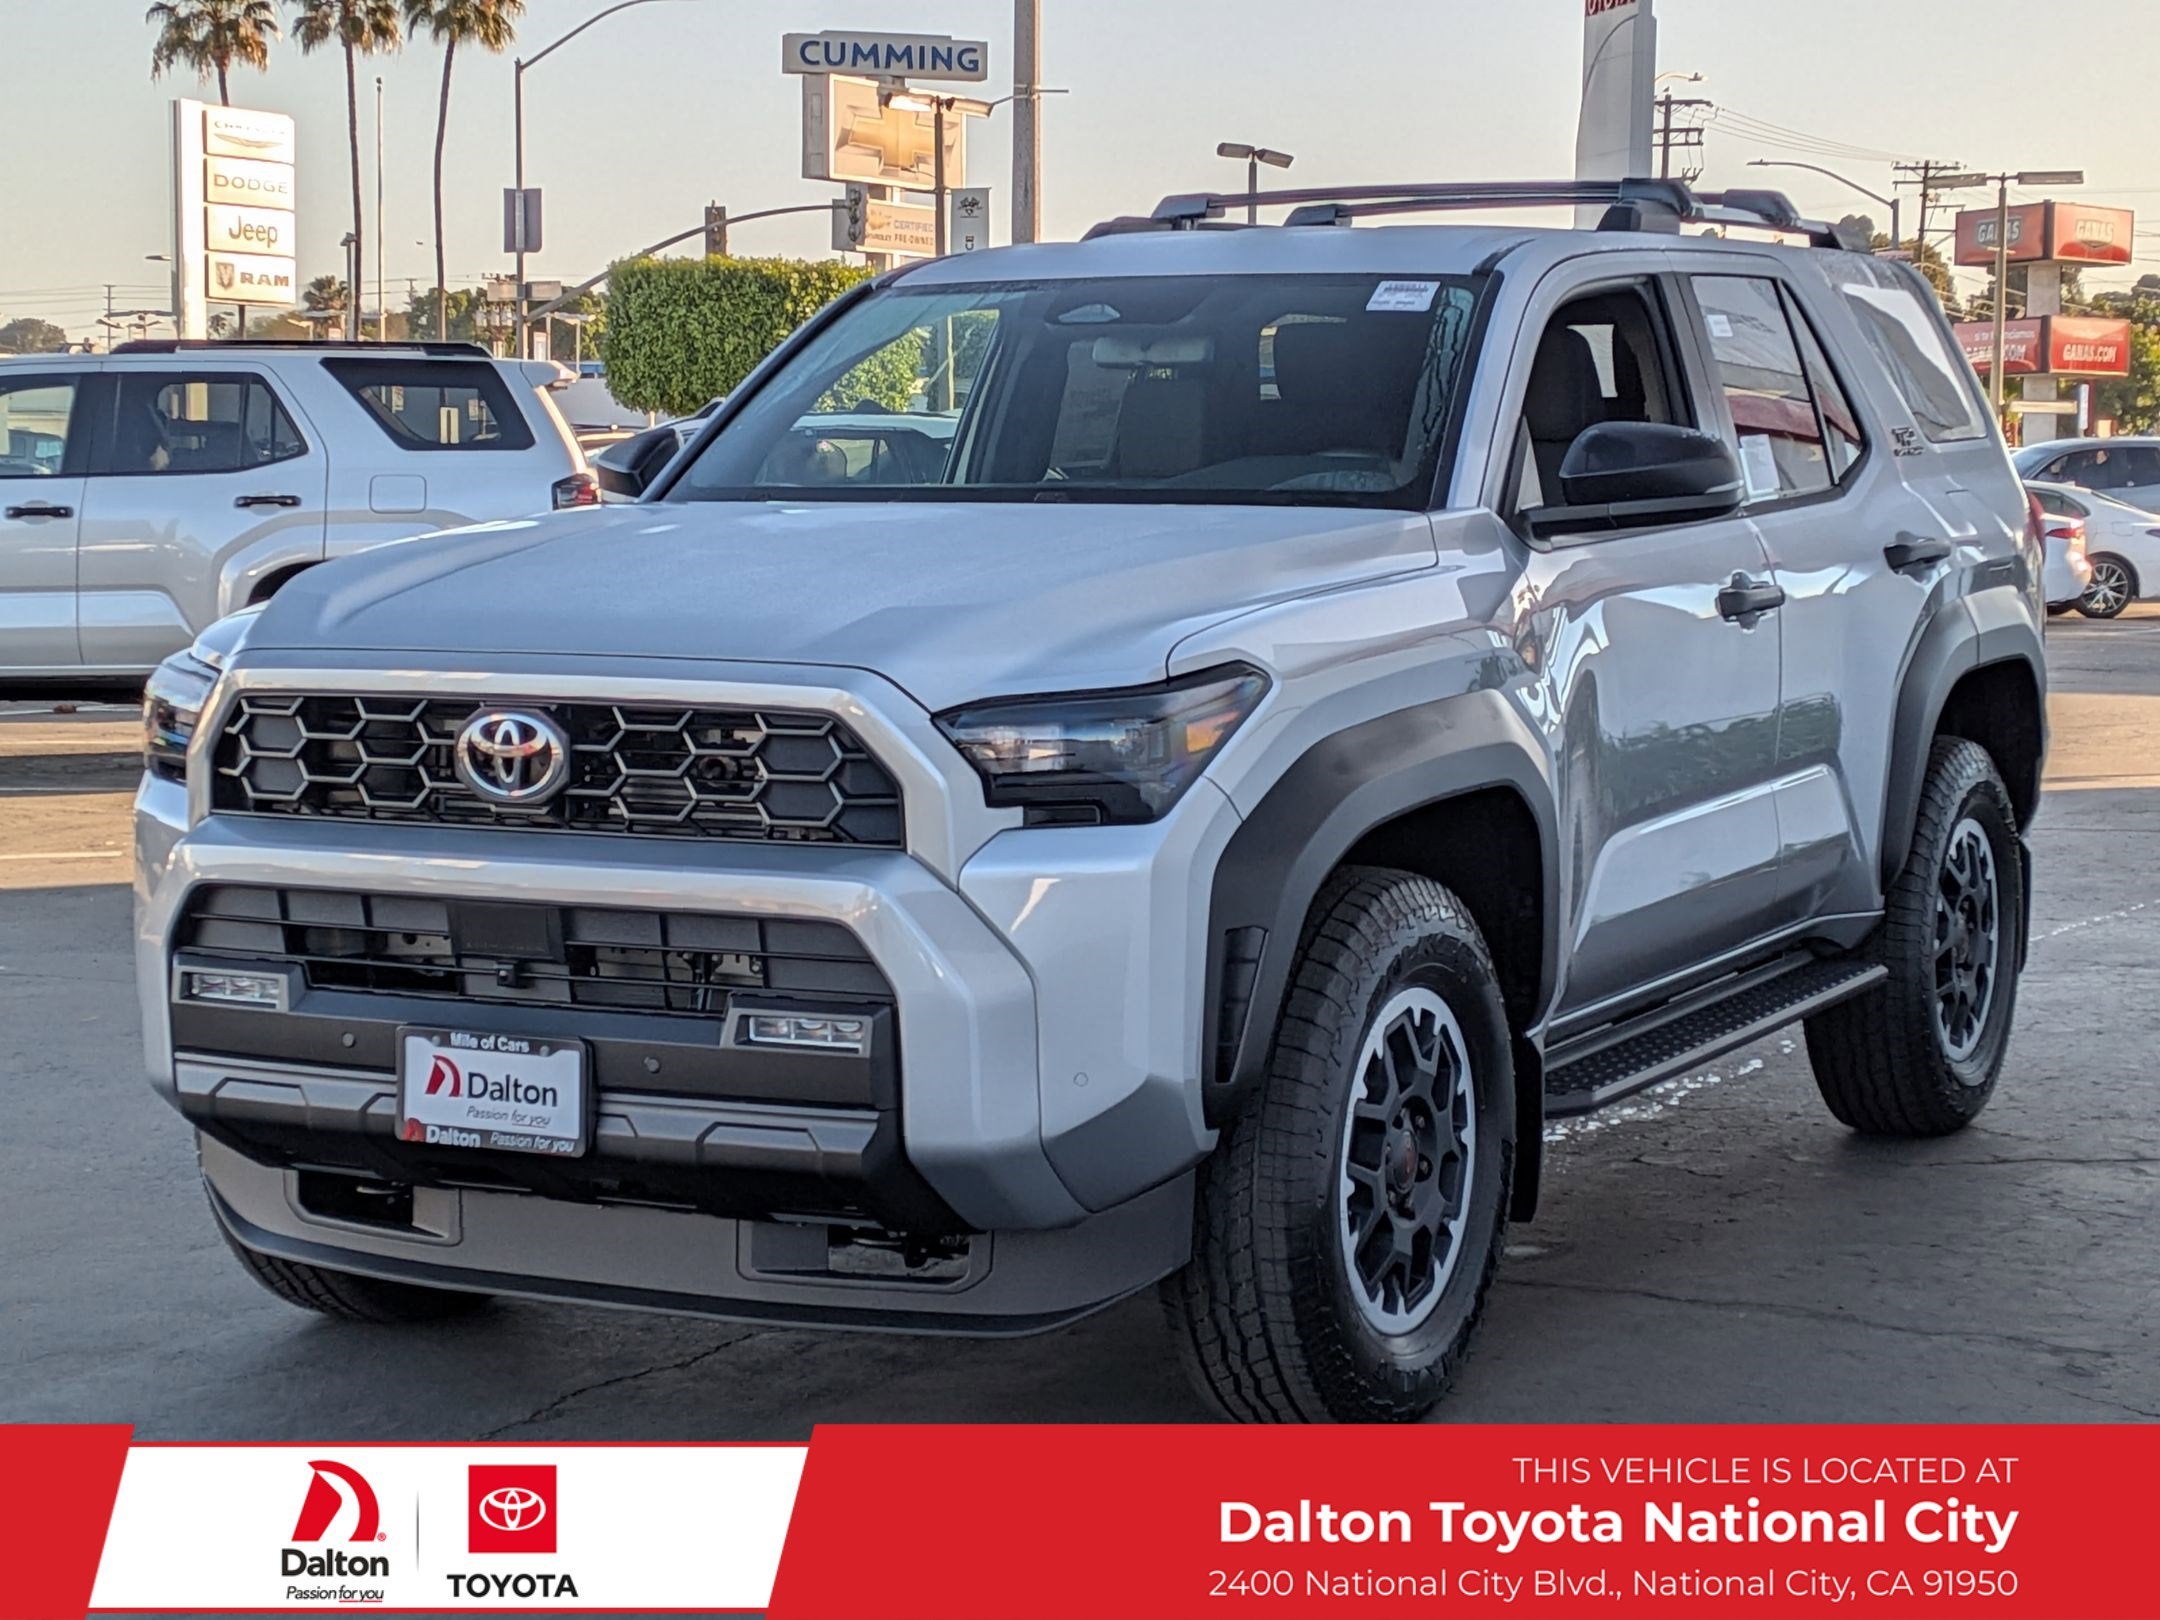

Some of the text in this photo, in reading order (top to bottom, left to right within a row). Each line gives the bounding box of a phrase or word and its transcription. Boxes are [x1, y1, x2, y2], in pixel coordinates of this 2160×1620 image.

[799, 40, 980, 73] CUMMING
[213, 173, 288, 194] DODGE
[228, 216, 278, 248] Jeep
[239, 271, 290, 288] RAM
[450, 1032, 530, 1053] Mile of Cars
[467, 1071, 558, 1107] Dalton
[466, 1105, 551, 1126] Passion for you
[426, 1125, 575, 1153] Dalton Passion for you
